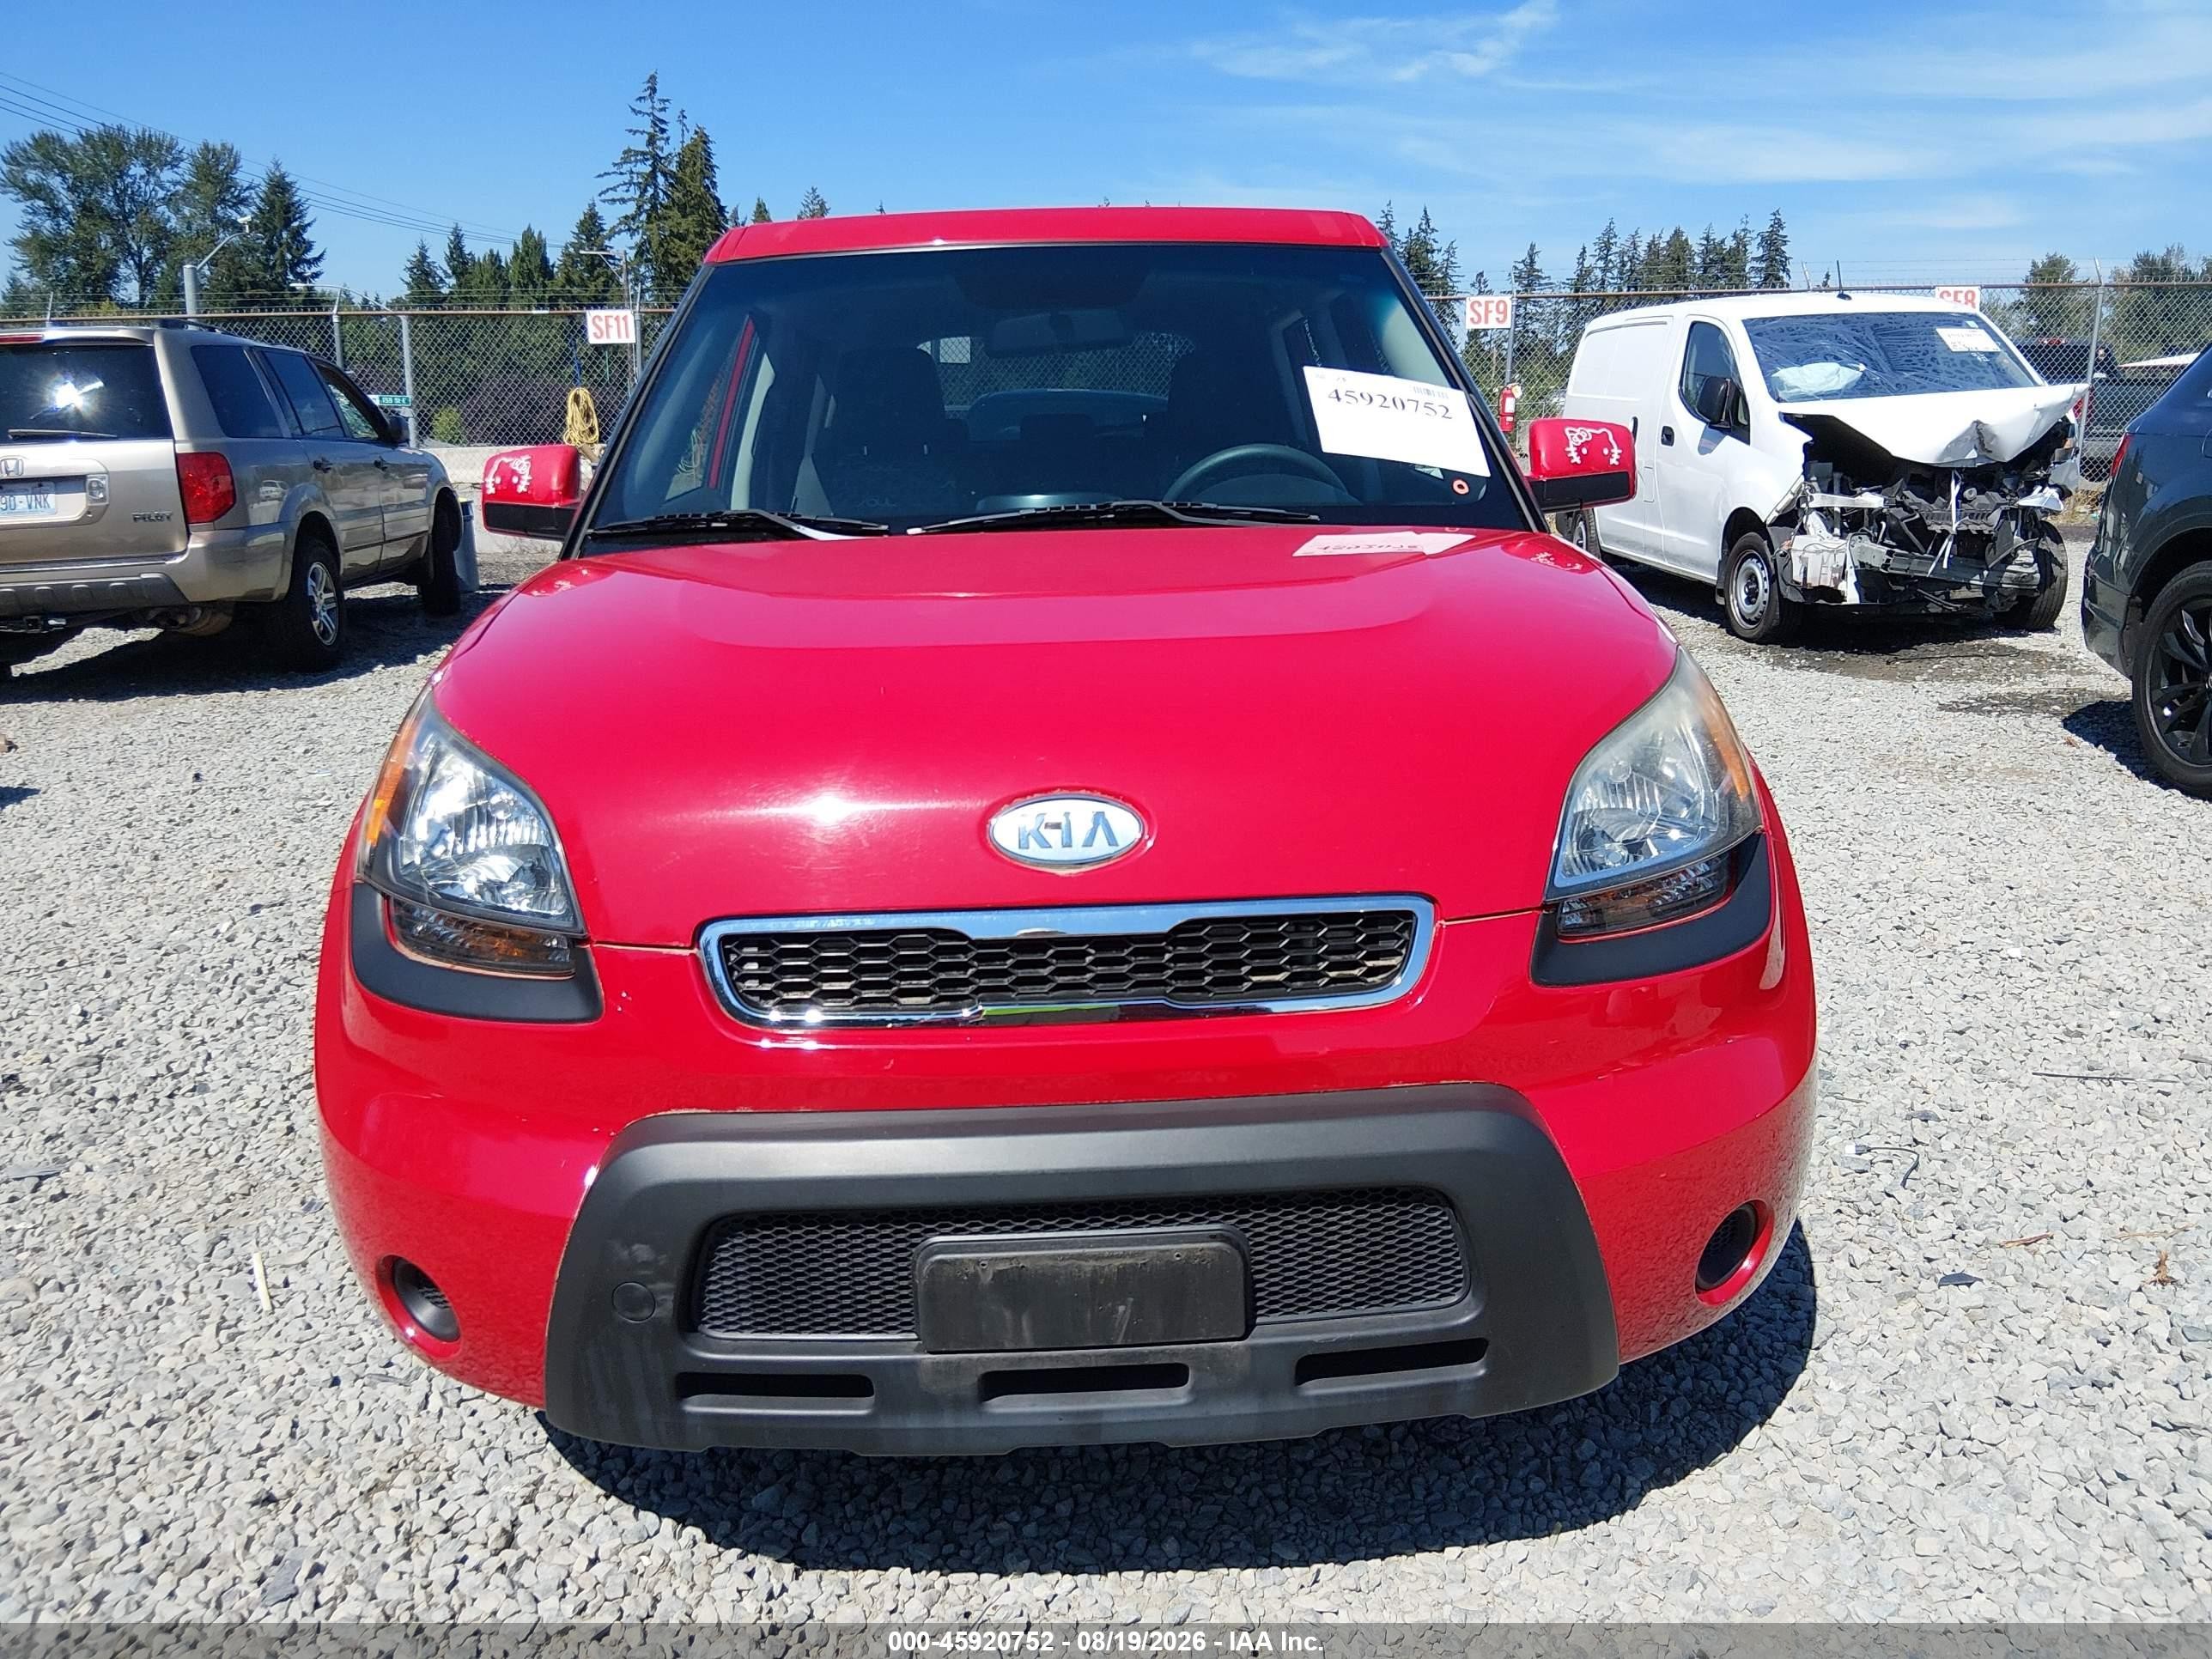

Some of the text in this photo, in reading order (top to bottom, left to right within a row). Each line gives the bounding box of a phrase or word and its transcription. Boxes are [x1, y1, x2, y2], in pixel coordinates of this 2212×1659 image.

[592, 314, 630, 339] SF11
[1469, 300, 1508, 325] SF9
[1328, 388, 1453, 419] 45920752
[1018, 811, 1120, 849] KIA
